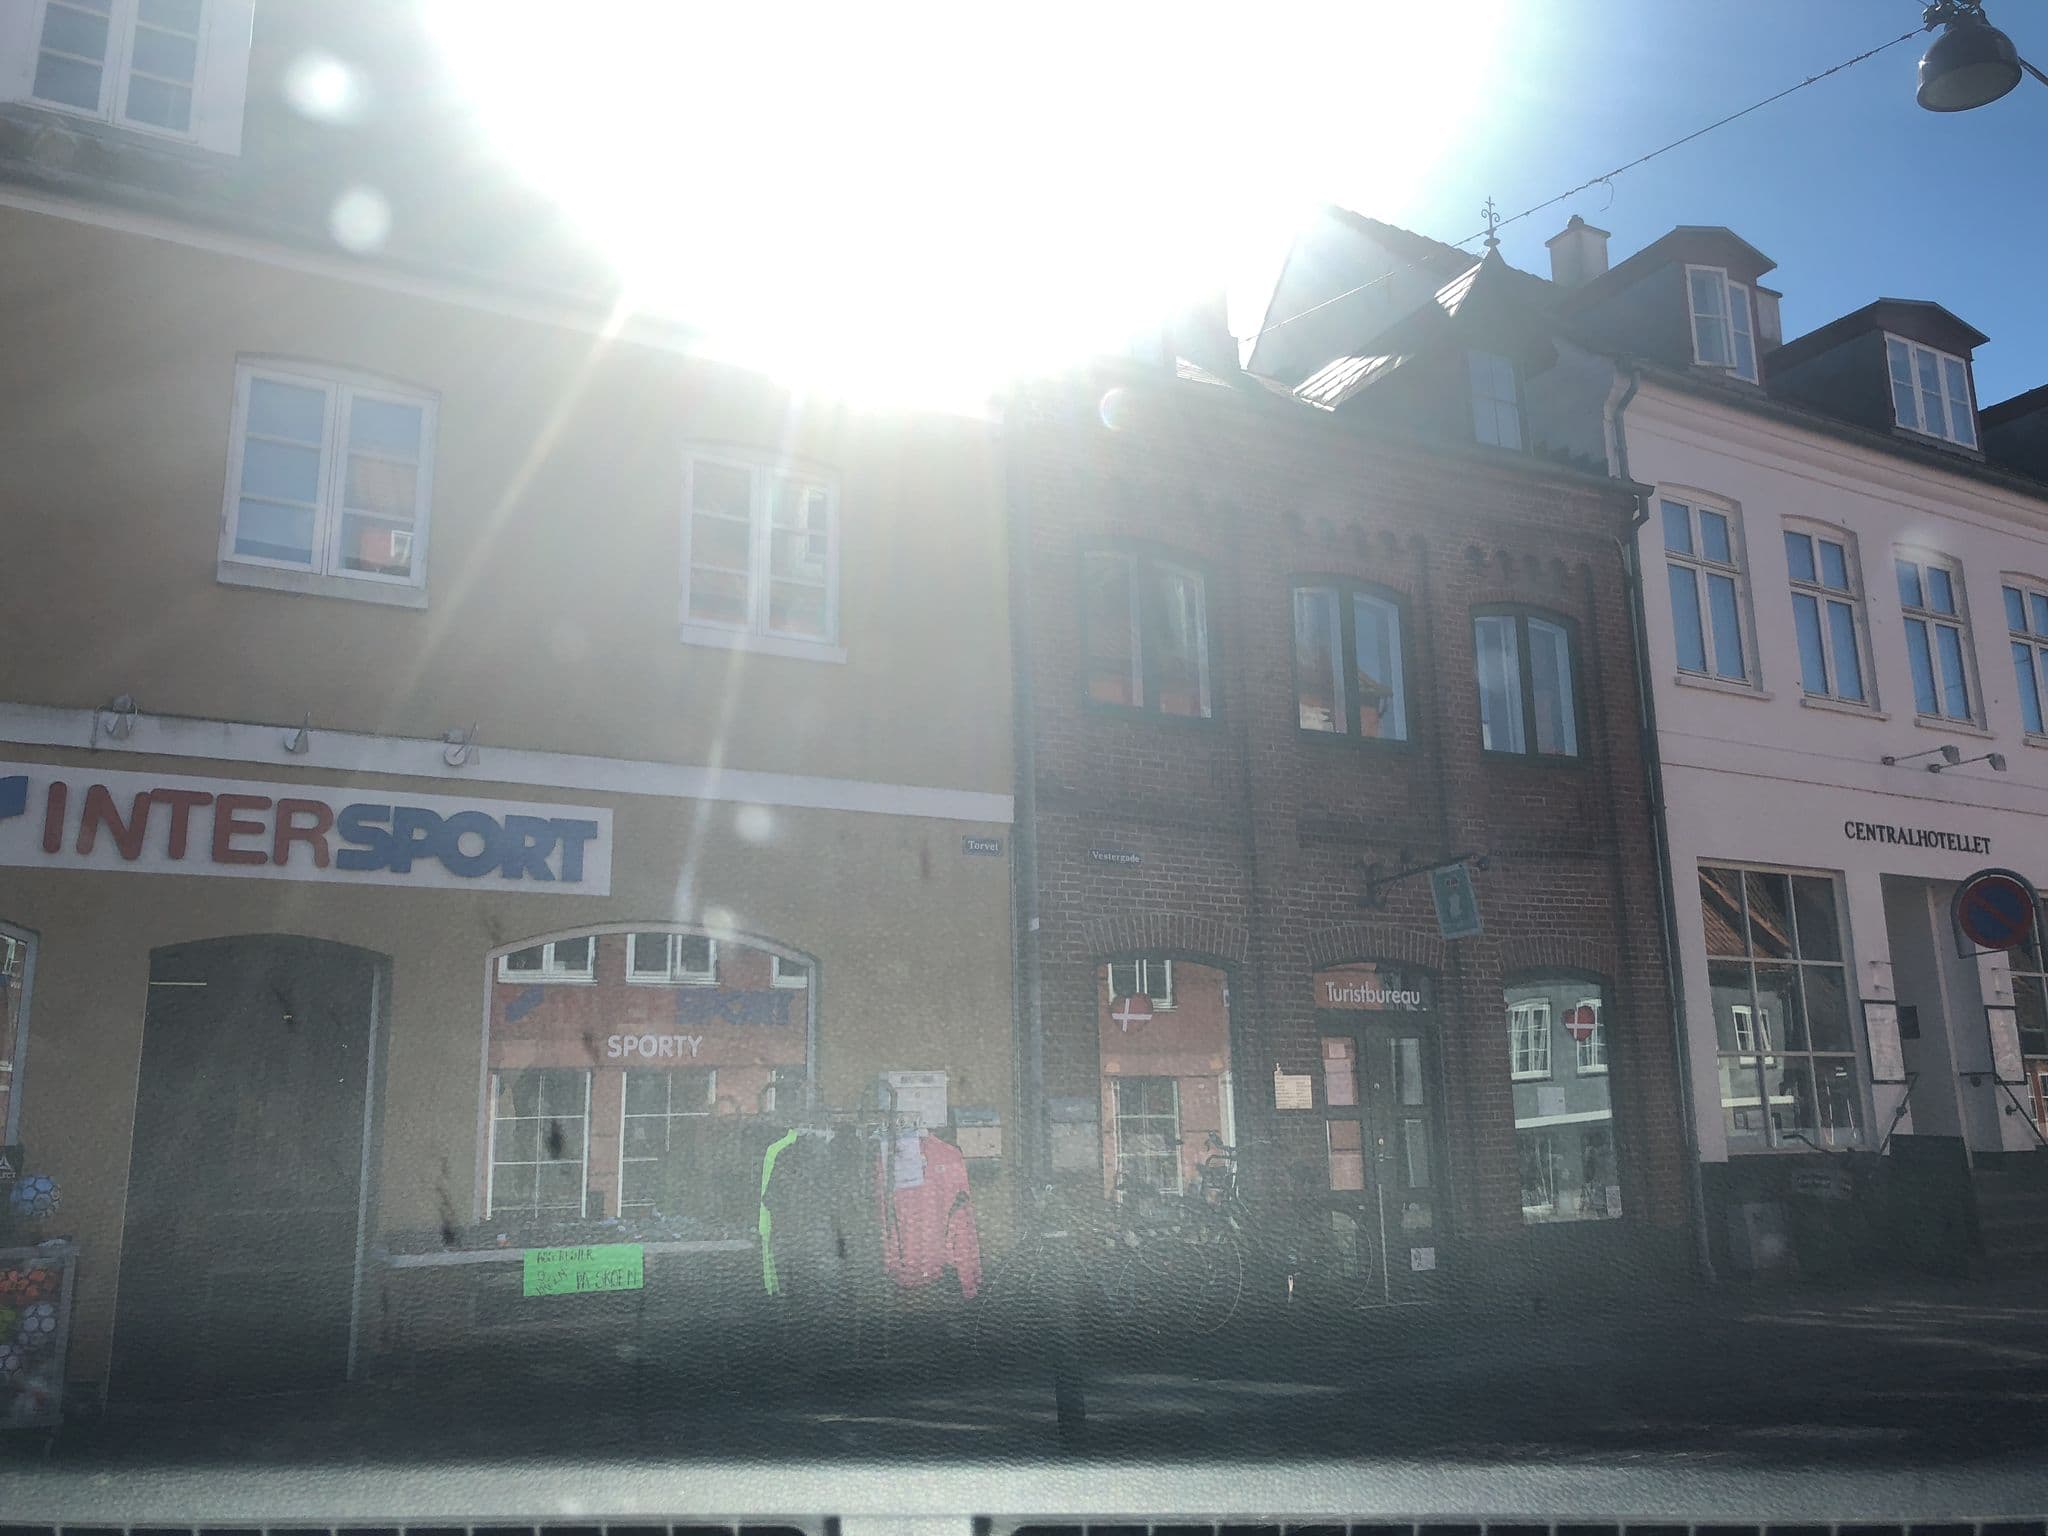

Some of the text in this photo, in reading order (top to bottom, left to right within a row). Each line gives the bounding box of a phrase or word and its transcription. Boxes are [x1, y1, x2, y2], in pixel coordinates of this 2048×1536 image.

[42, 780, 598, 883] INTERSPORT
[1844, 820, 1991, 855] CENTRALHOTELLET
[1325, 981, 1420, 1005] Turistbureau
[607, 1034, 703, 1058] SPORTY
